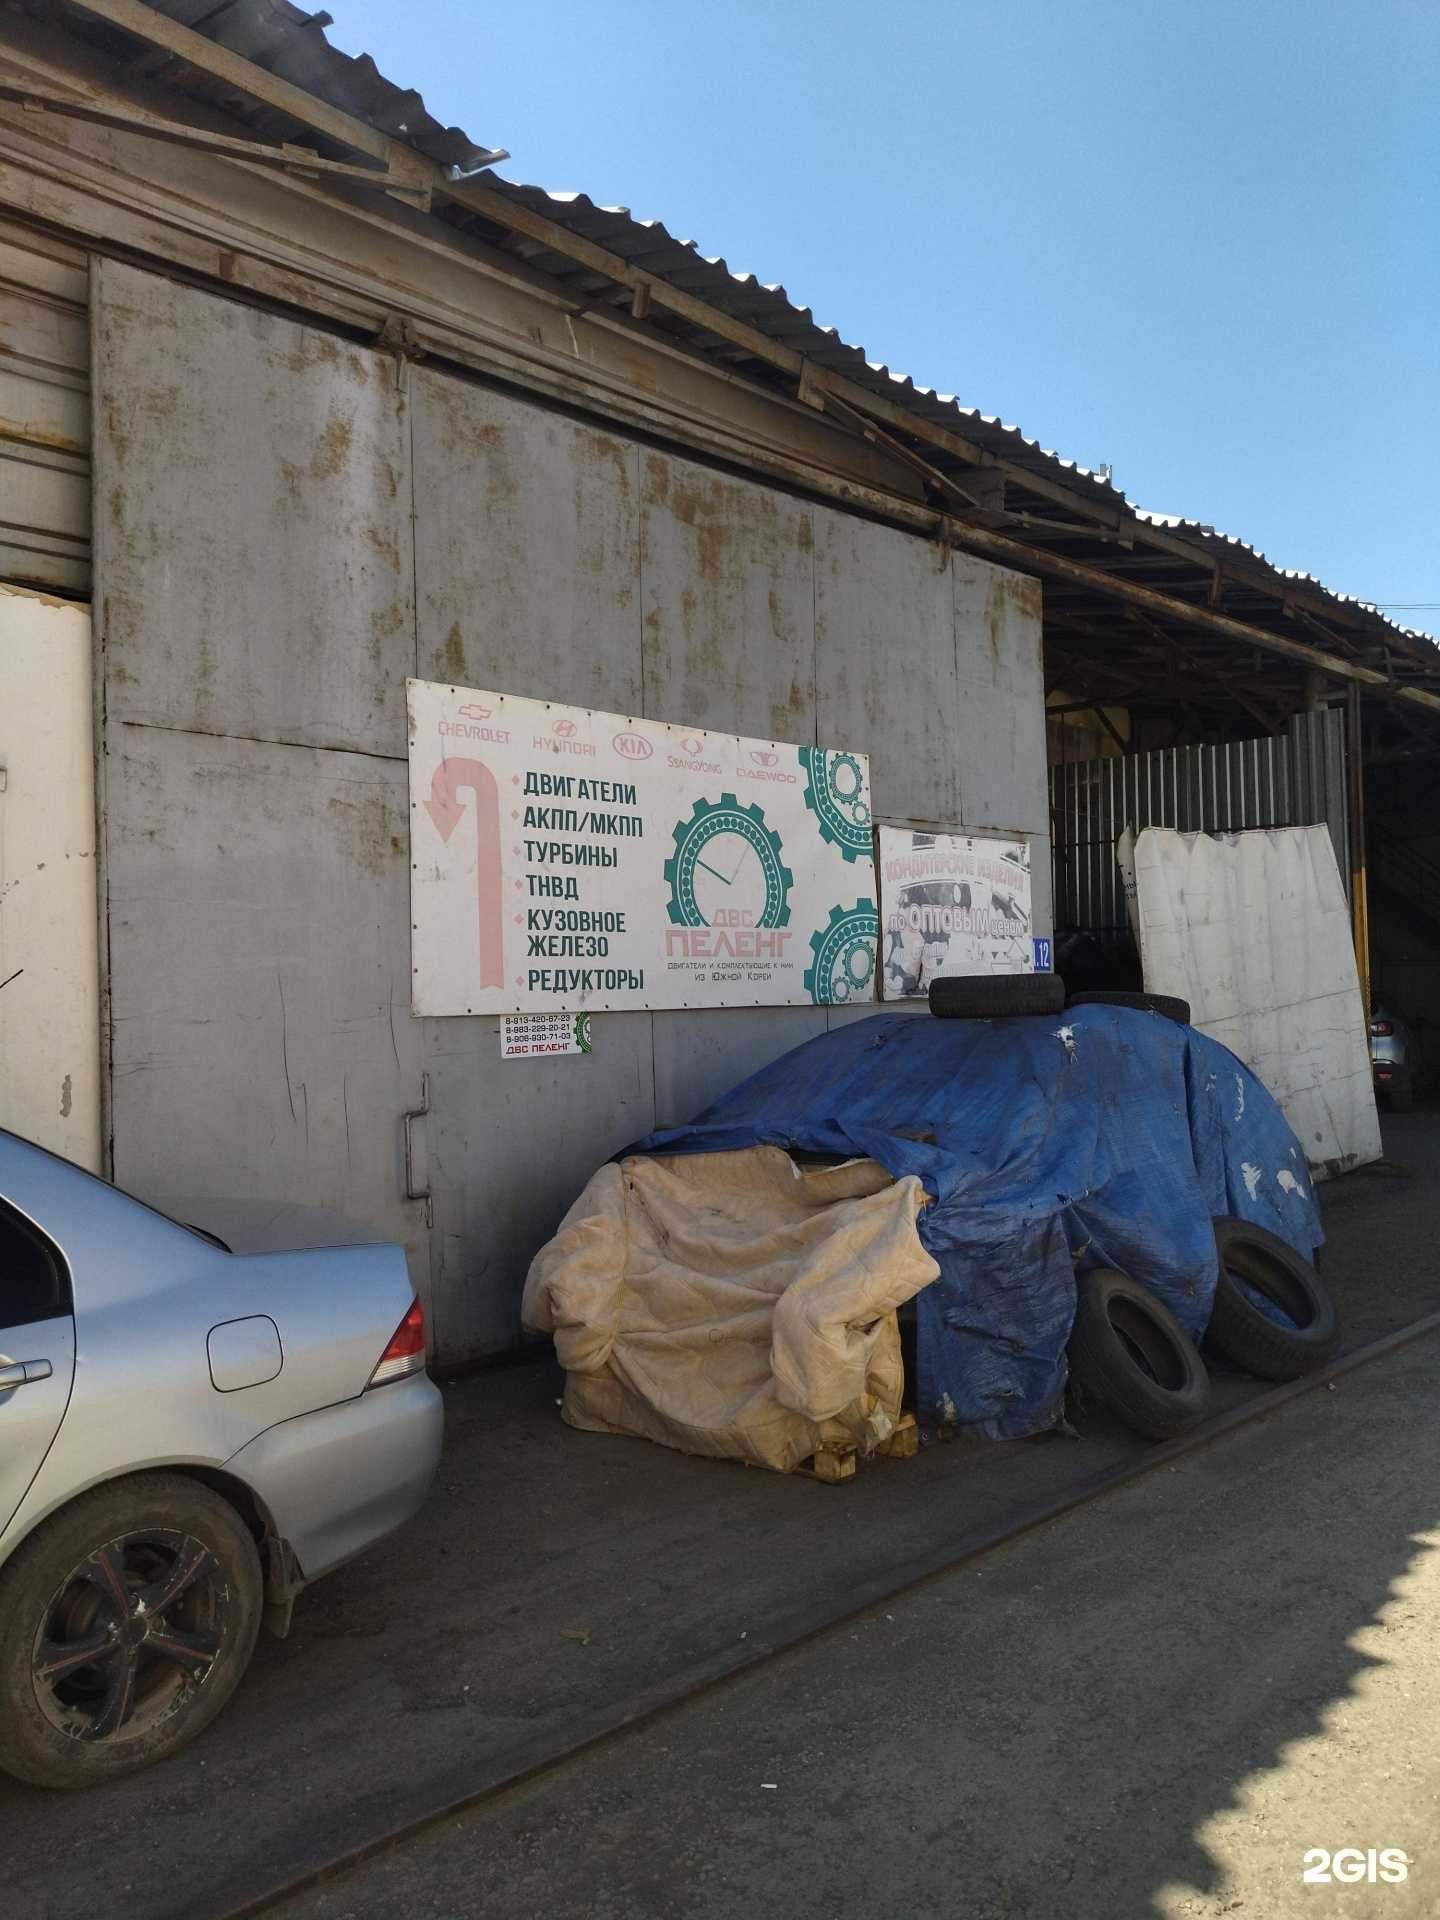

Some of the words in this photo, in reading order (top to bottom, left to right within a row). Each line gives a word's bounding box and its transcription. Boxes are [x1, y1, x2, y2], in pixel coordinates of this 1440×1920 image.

[438, 721, 511, 744] CHEVROLET
[532, 736, 597, 757] HYUNDAI
[619, 737, 648, 755] KIA
[736, 767, 797, 784] DAEWOO
[523, 771, 637, 805] ДВИГАТЕЛИ
[523, 806, 643, 837] АКПП/МКПП
[524, 840, 618, 868] ТУРБИНЫ
[526, 874, 579, 901] ТНВД
[527, 909, 626, 933] КУЗОВНОЕ
[710, 909, 754, 928] ДВС
[527, 935, 609, 957] ЖЕЛЕЗО
[665, 930, 793, 957] ПЕЛЕНГ
[528, 969, 644, 993] РЕДУКТОРЫ
[506, 1046, 528, 1054] ДВС
[532, 1043, 570, 1052] ПЕЛЕНГ
